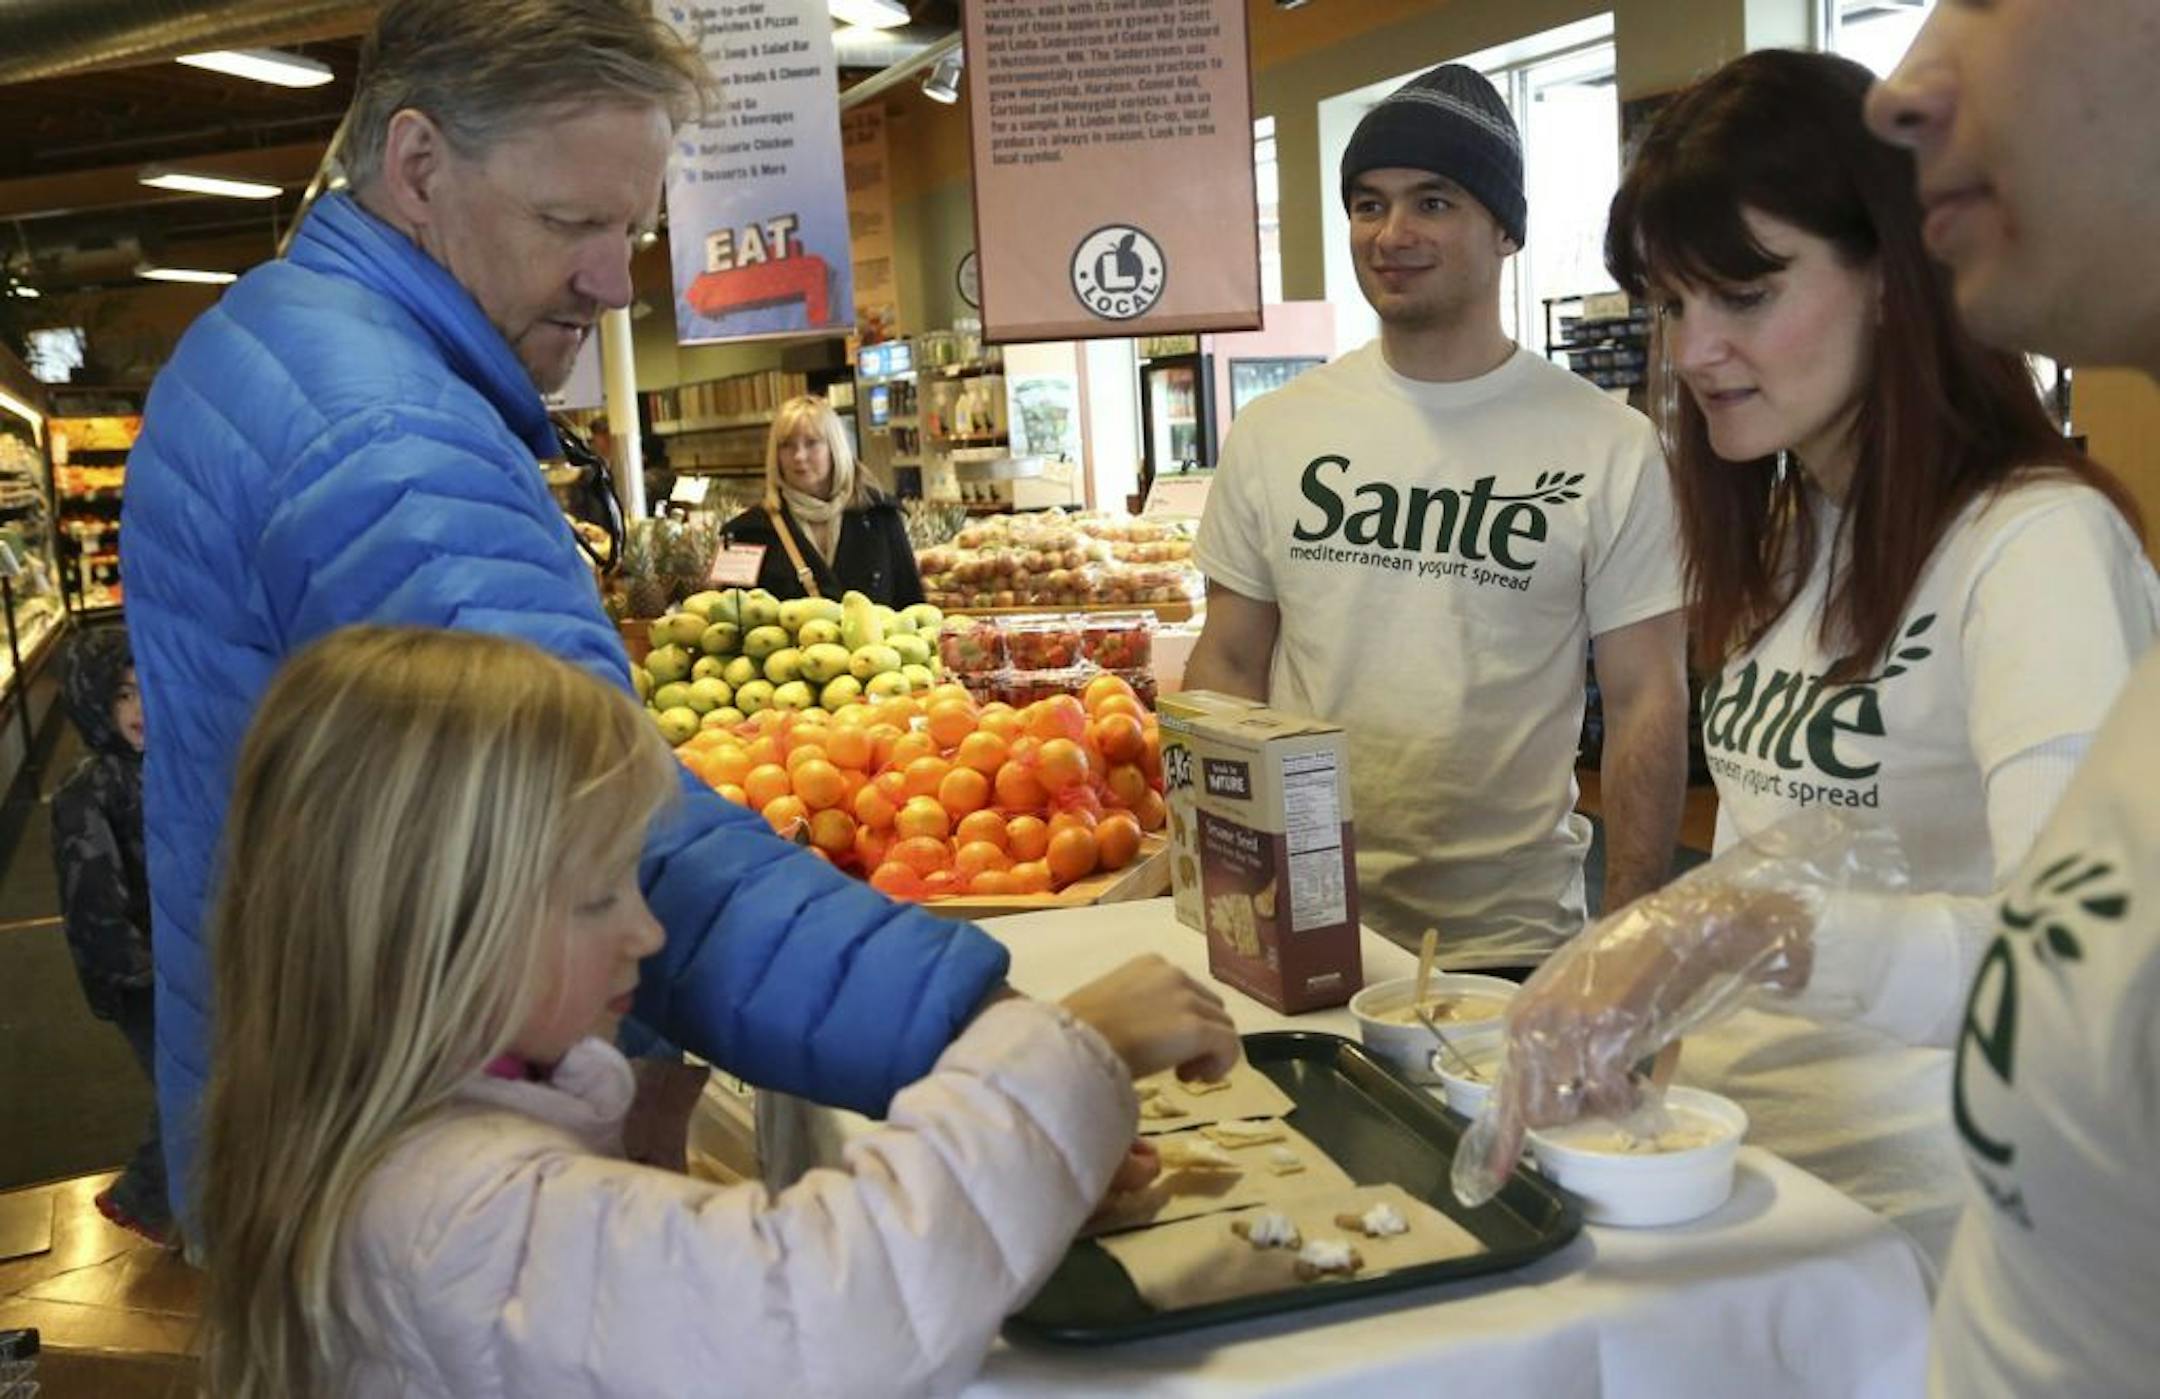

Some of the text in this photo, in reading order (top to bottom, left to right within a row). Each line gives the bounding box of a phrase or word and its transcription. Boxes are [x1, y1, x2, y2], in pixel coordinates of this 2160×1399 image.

[761, 162, 786, 177] More
[705, 214, 797, 275] EAT
[1083, 284, 1159, 314] LOCAL
[1289, 543, 1531, 592] mediterranean yogurt spread
[1787, 781, 1879, 809] spread
